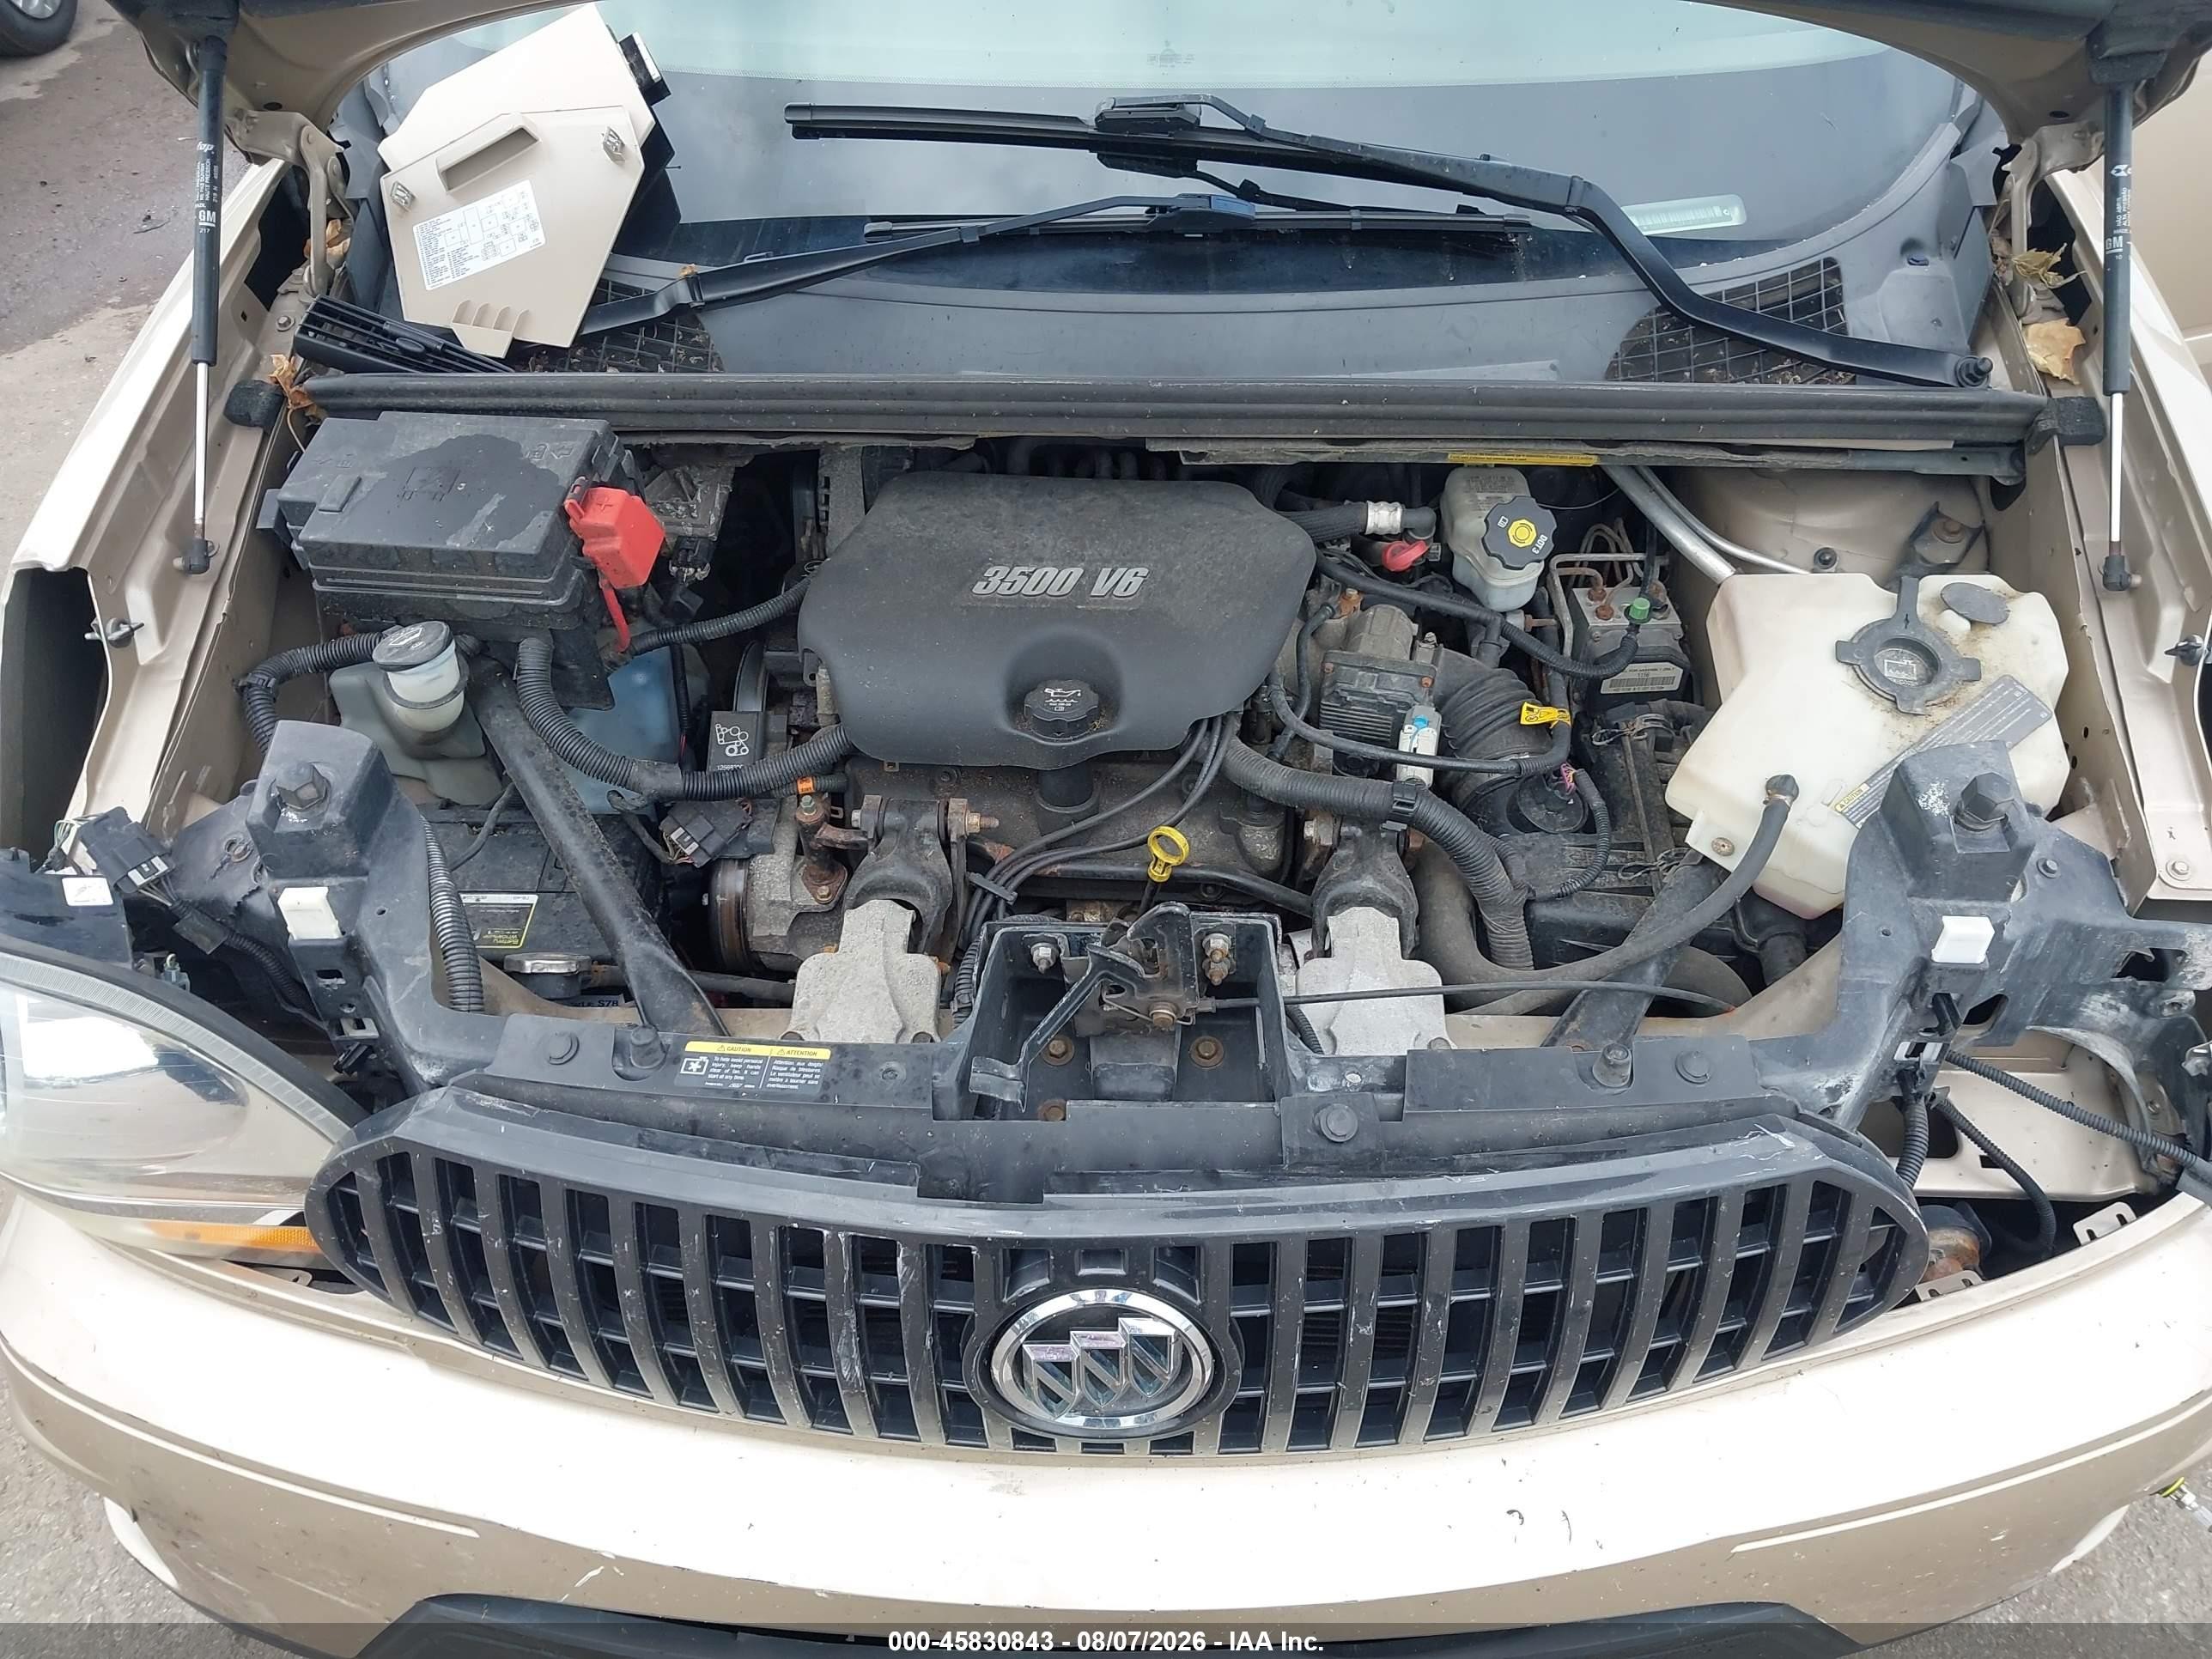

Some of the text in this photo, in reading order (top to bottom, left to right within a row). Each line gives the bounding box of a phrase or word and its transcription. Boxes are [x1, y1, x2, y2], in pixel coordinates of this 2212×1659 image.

[198, 210, 216, 223] GM
[2106, 235, 2124, 250] GM
[1531, 534, 1548, 555] DOT 3
[971, 565, 1150, 598] 3500 V6
